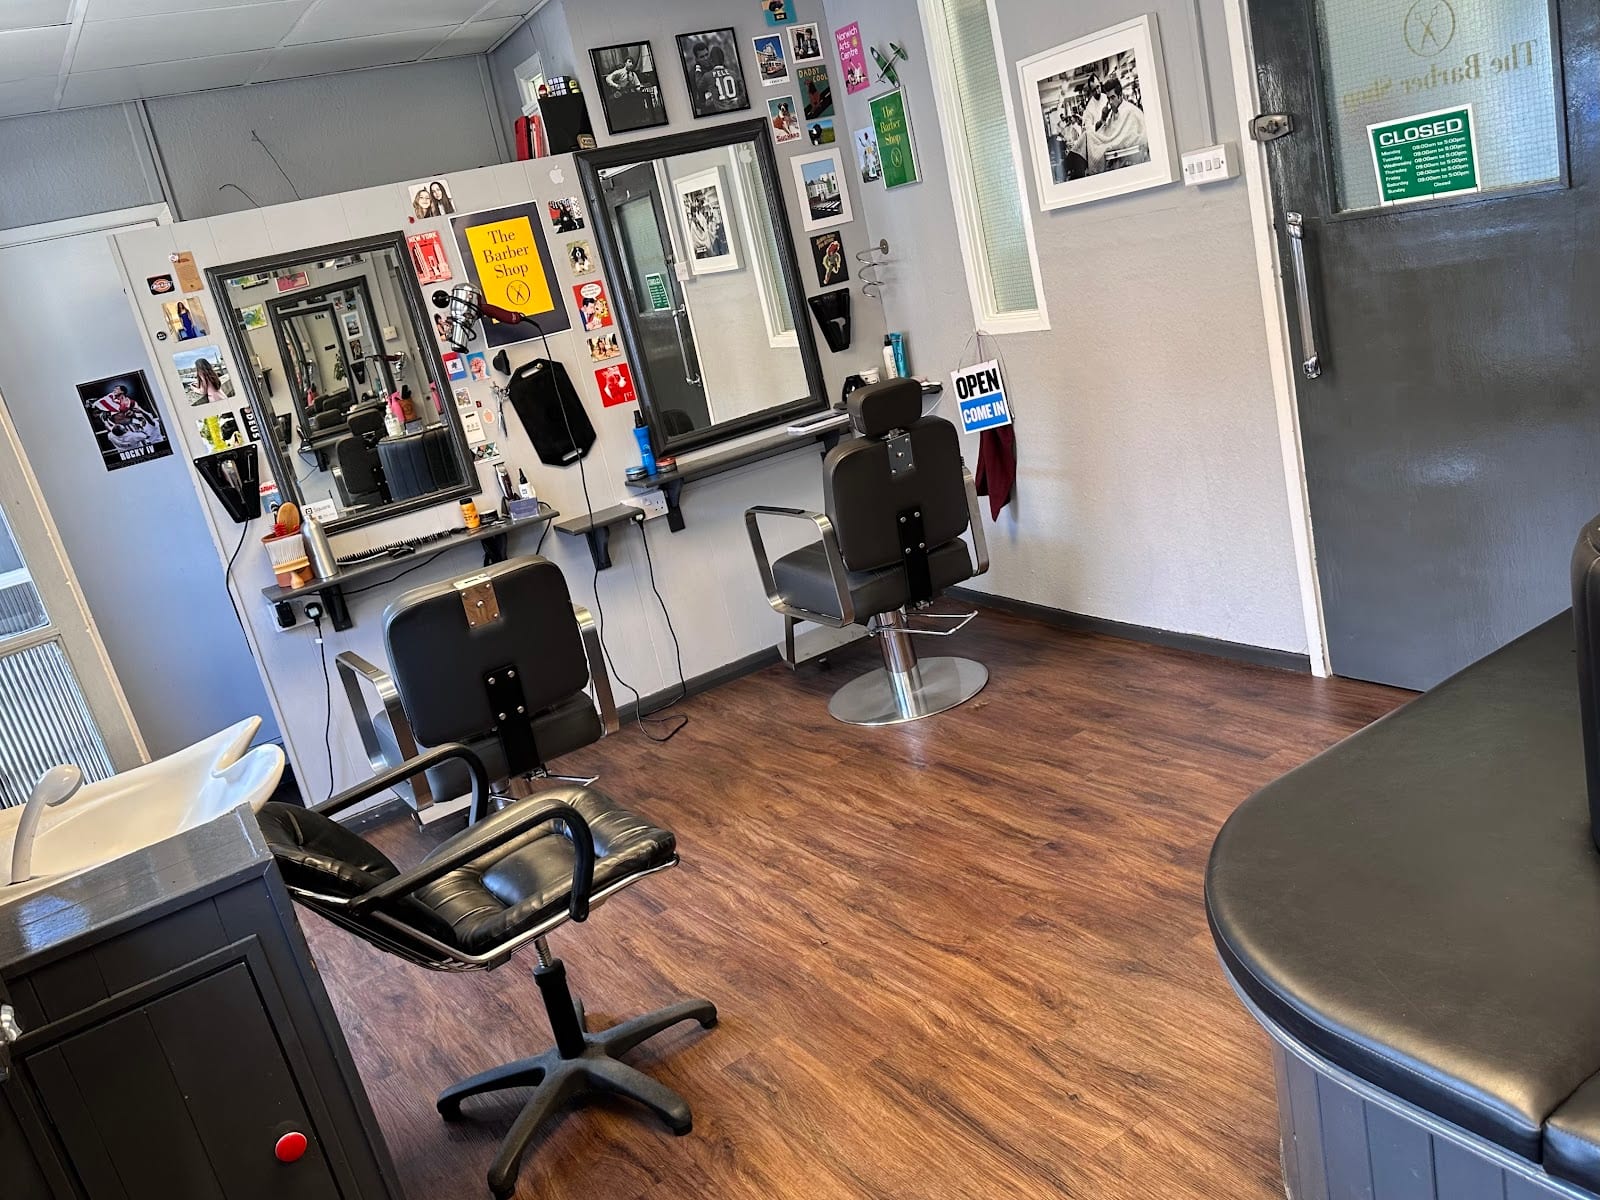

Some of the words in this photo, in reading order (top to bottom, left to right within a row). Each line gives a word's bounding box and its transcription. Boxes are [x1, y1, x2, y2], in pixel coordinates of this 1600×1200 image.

[836, 26, 857, 41] Norwich
[839, 42, 850, 52] Arts
[840, 47, 858, 61] Centre
[713, 69, 730, 77] PELE
[798, 67, 820, 79] DADDY
[813, 74, 828, 83] COOL
[715, 76, 736, 100] 10
[882, 106, 894, 119] The
[879, 120, 900, 133] Barber
[1380, 118, 1462, 146] CLOSED
[884, 134, 901, 146] Shop
[408, 235, 421, 243] NEW
[421, 231, 438, 240] YORK
[487, 230, 516, 245] The
[483, 245, 529, 264] Barber
[494, 264, 529, 278] Shop
[956, 368, 1000, 400] OPEN
[963, 404, 993, 424] COME
[993, 401, 1005, 417] IN
[246, 413, 260, 439] DEUS
[120, 447, 144, 460] ROCKY
[146, 445, 155, 454] IV
[260, 484, 277, 493] JAWS
